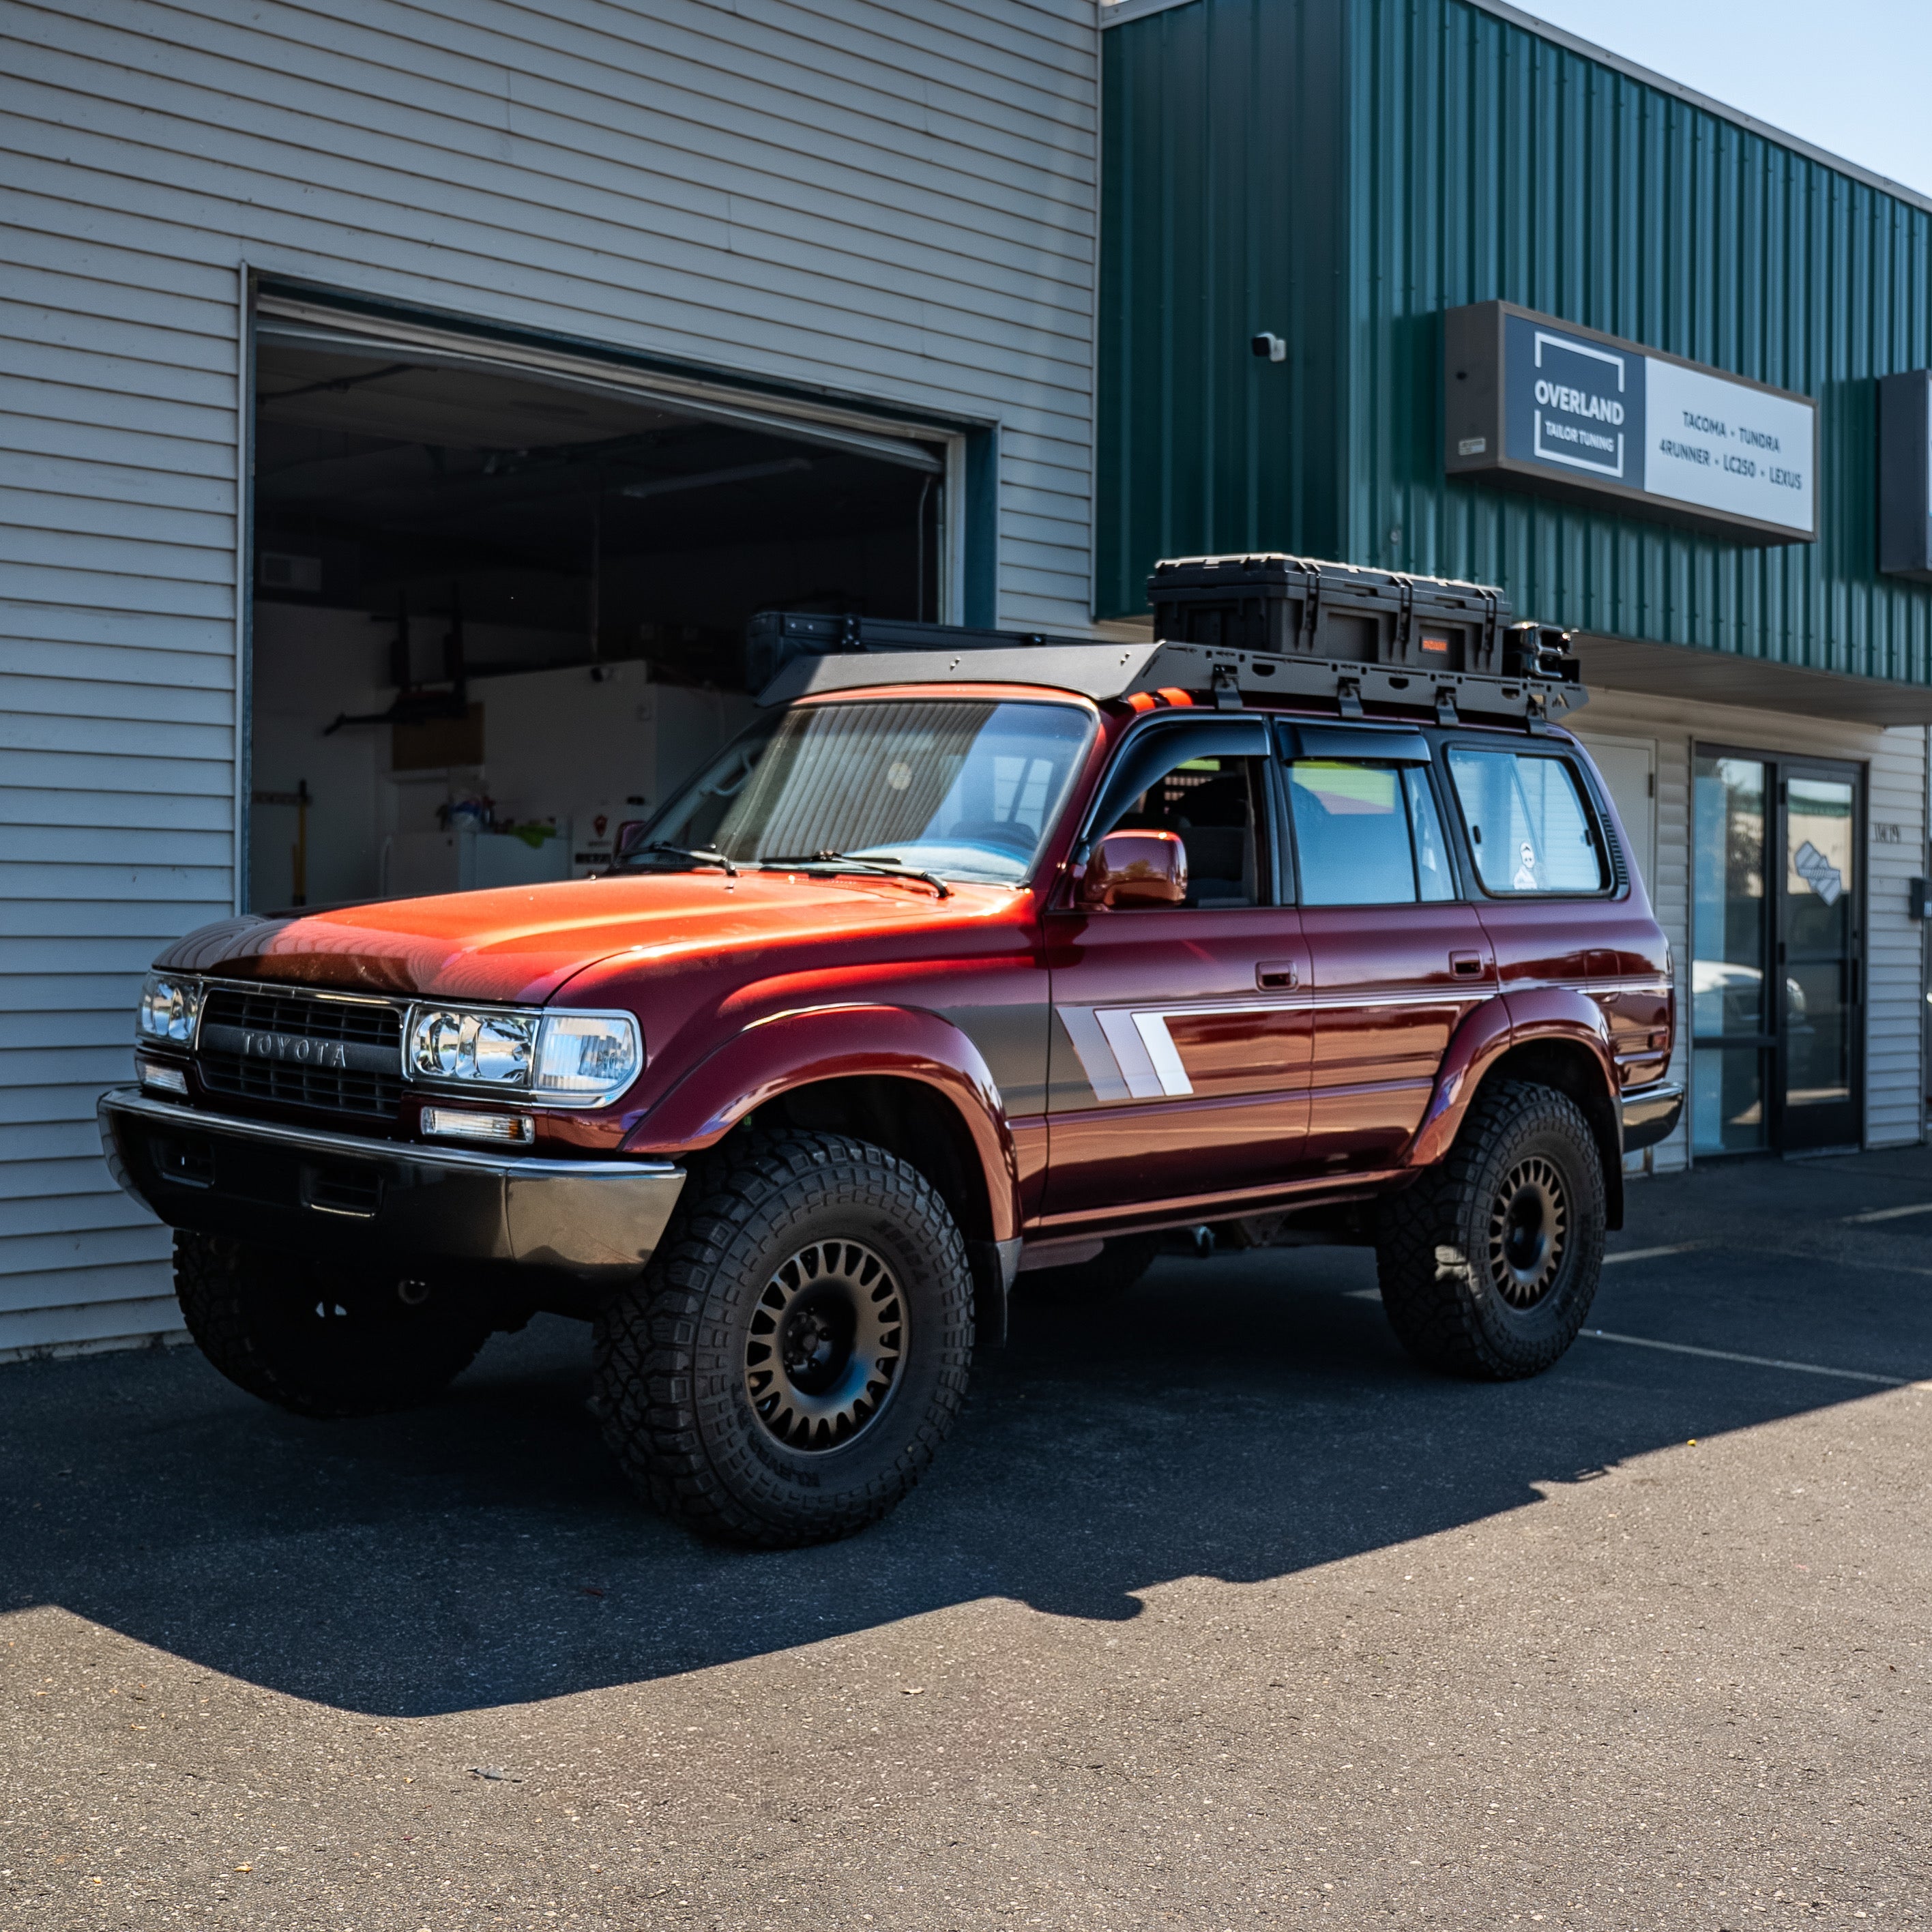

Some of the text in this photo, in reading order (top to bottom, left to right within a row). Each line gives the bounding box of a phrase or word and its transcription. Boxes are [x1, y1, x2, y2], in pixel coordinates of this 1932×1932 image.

[1535, 379, 1624, 426] OVERLAND
[1545, 420, 1615, 452] TAILOR TUNING
[1682, 411, 1781, 453] TACOMA TUNDRA
[1659, 439, 1802, 490] 4RUNNER LC250 LEXUS
[242, 1031, 346, 1068] TOYOTA
